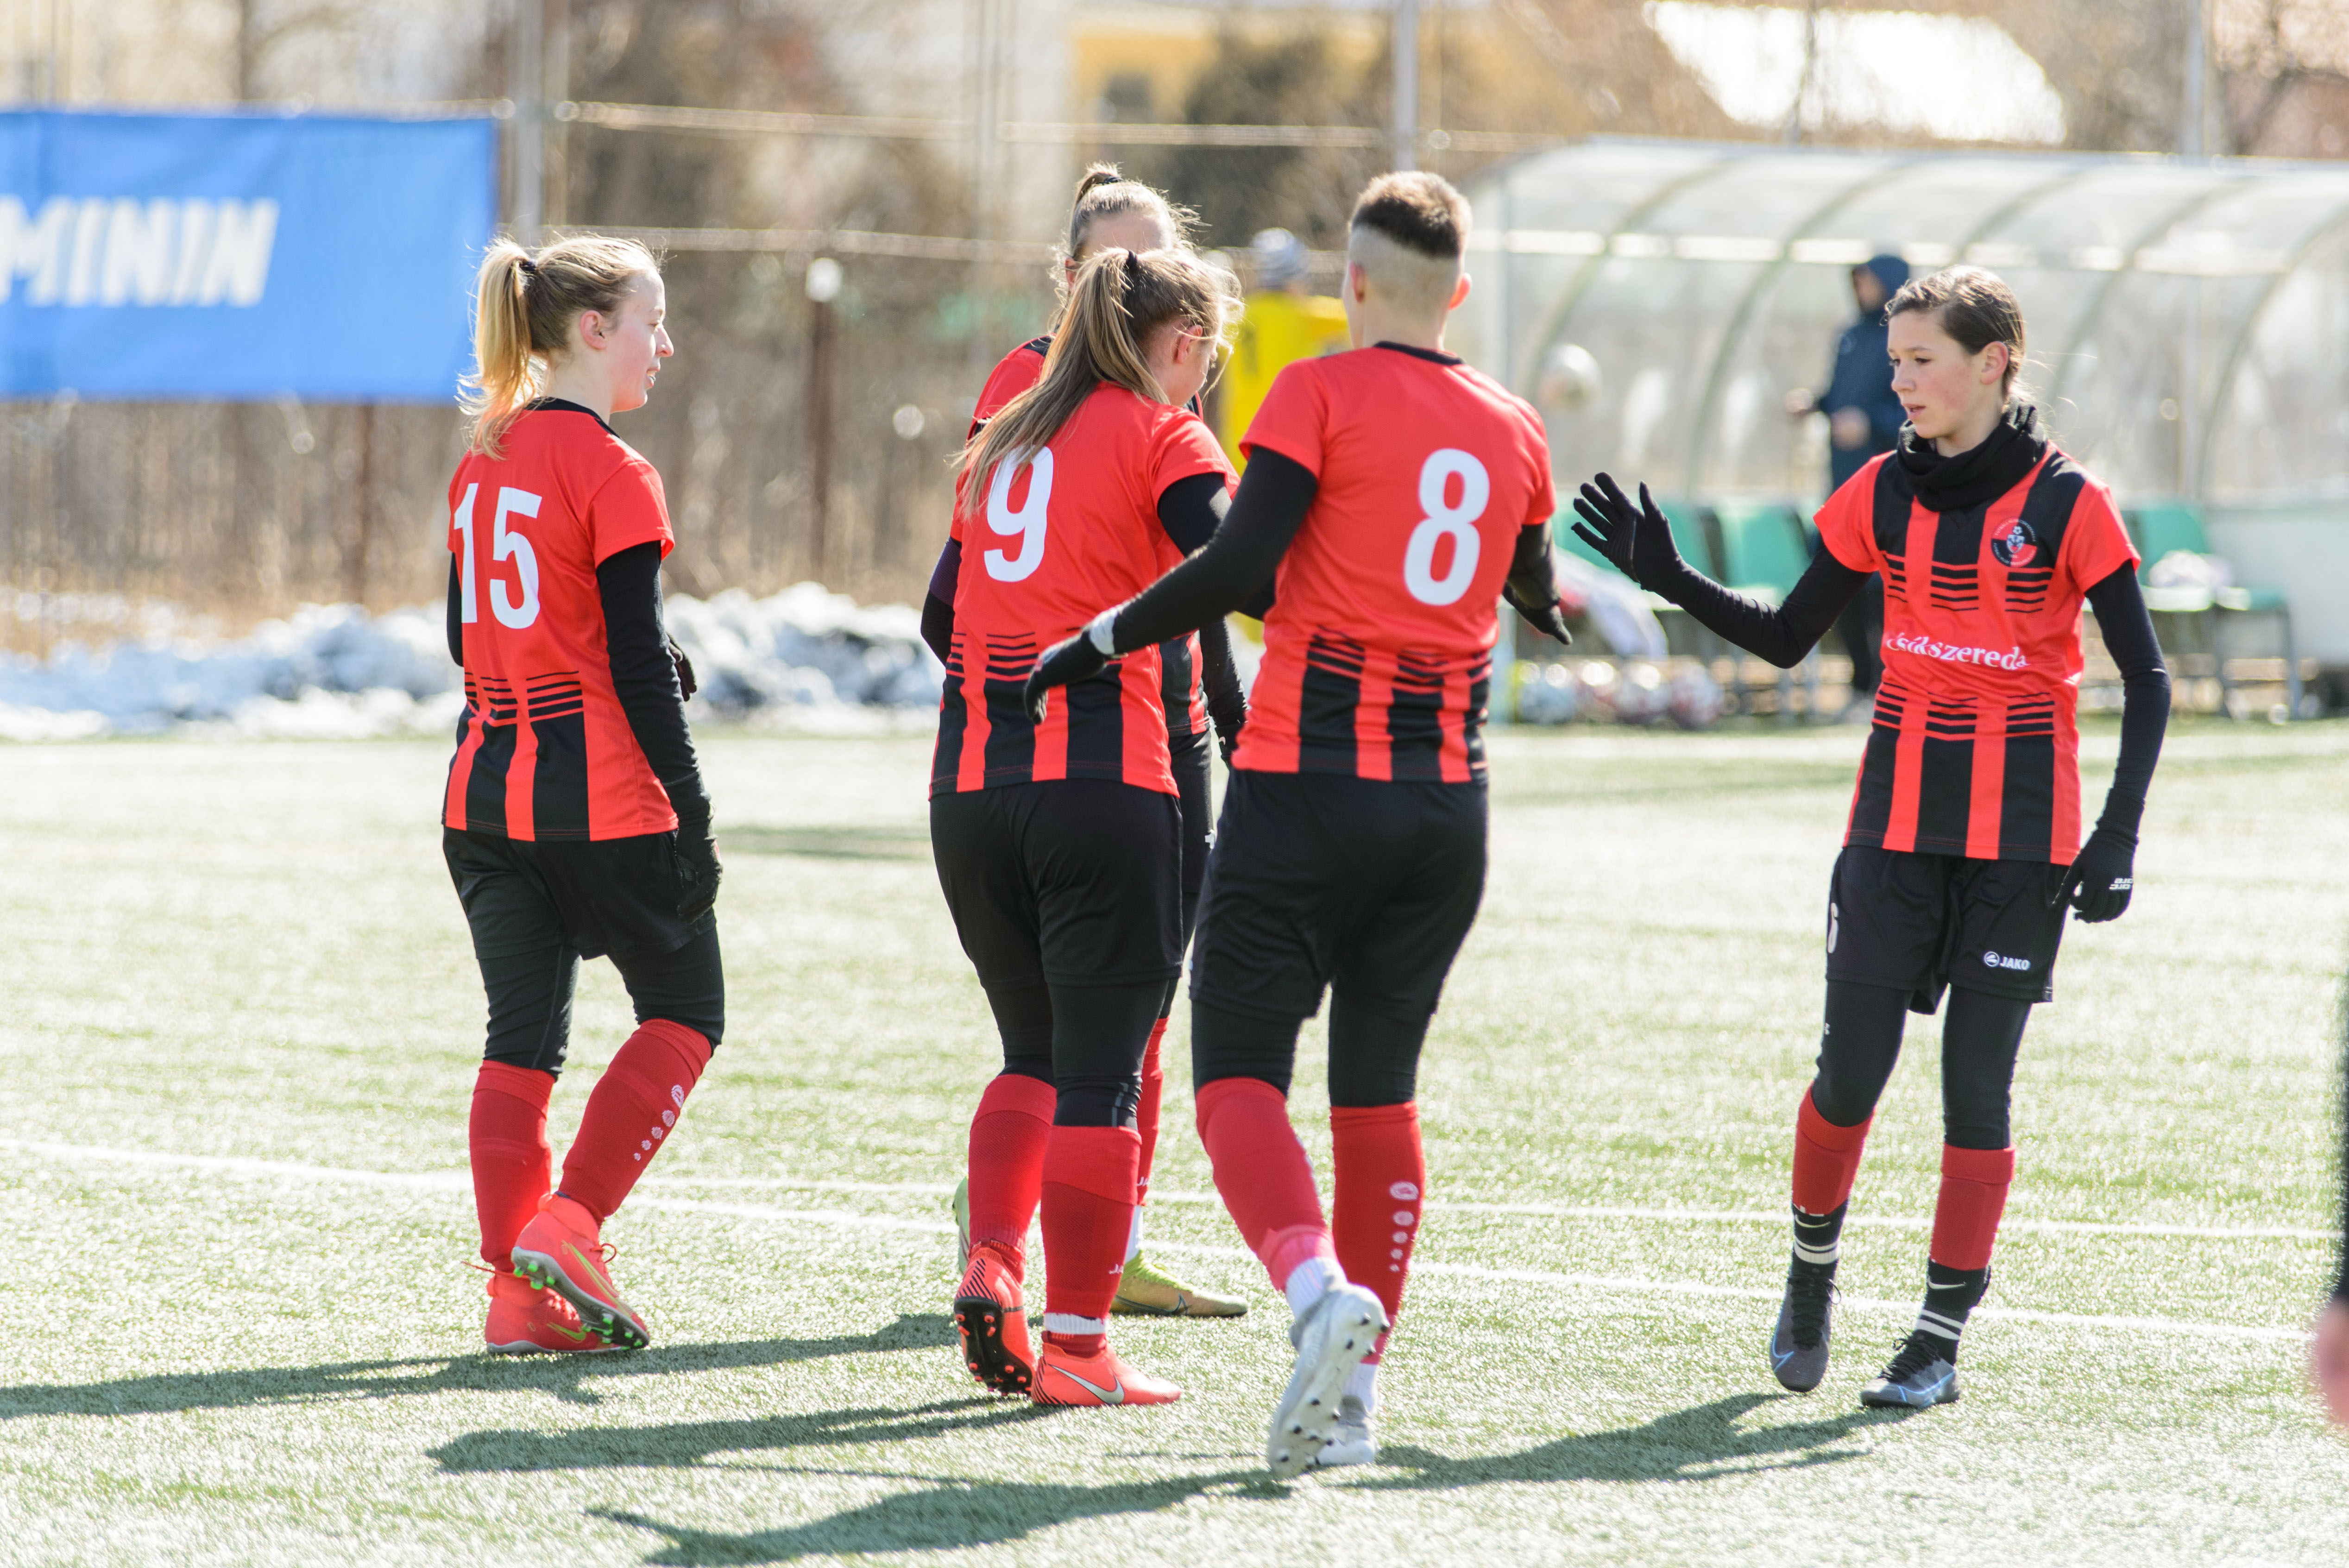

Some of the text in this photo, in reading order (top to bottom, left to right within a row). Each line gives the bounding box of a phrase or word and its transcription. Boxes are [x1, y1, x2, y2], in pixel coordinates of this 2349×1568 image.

[454, 483, 542, 629] 15
[984, 444, 1053, 582] 9
[1404, 447, 1490, 606] 8
[2000, 956, 2030, 970] JAKO
